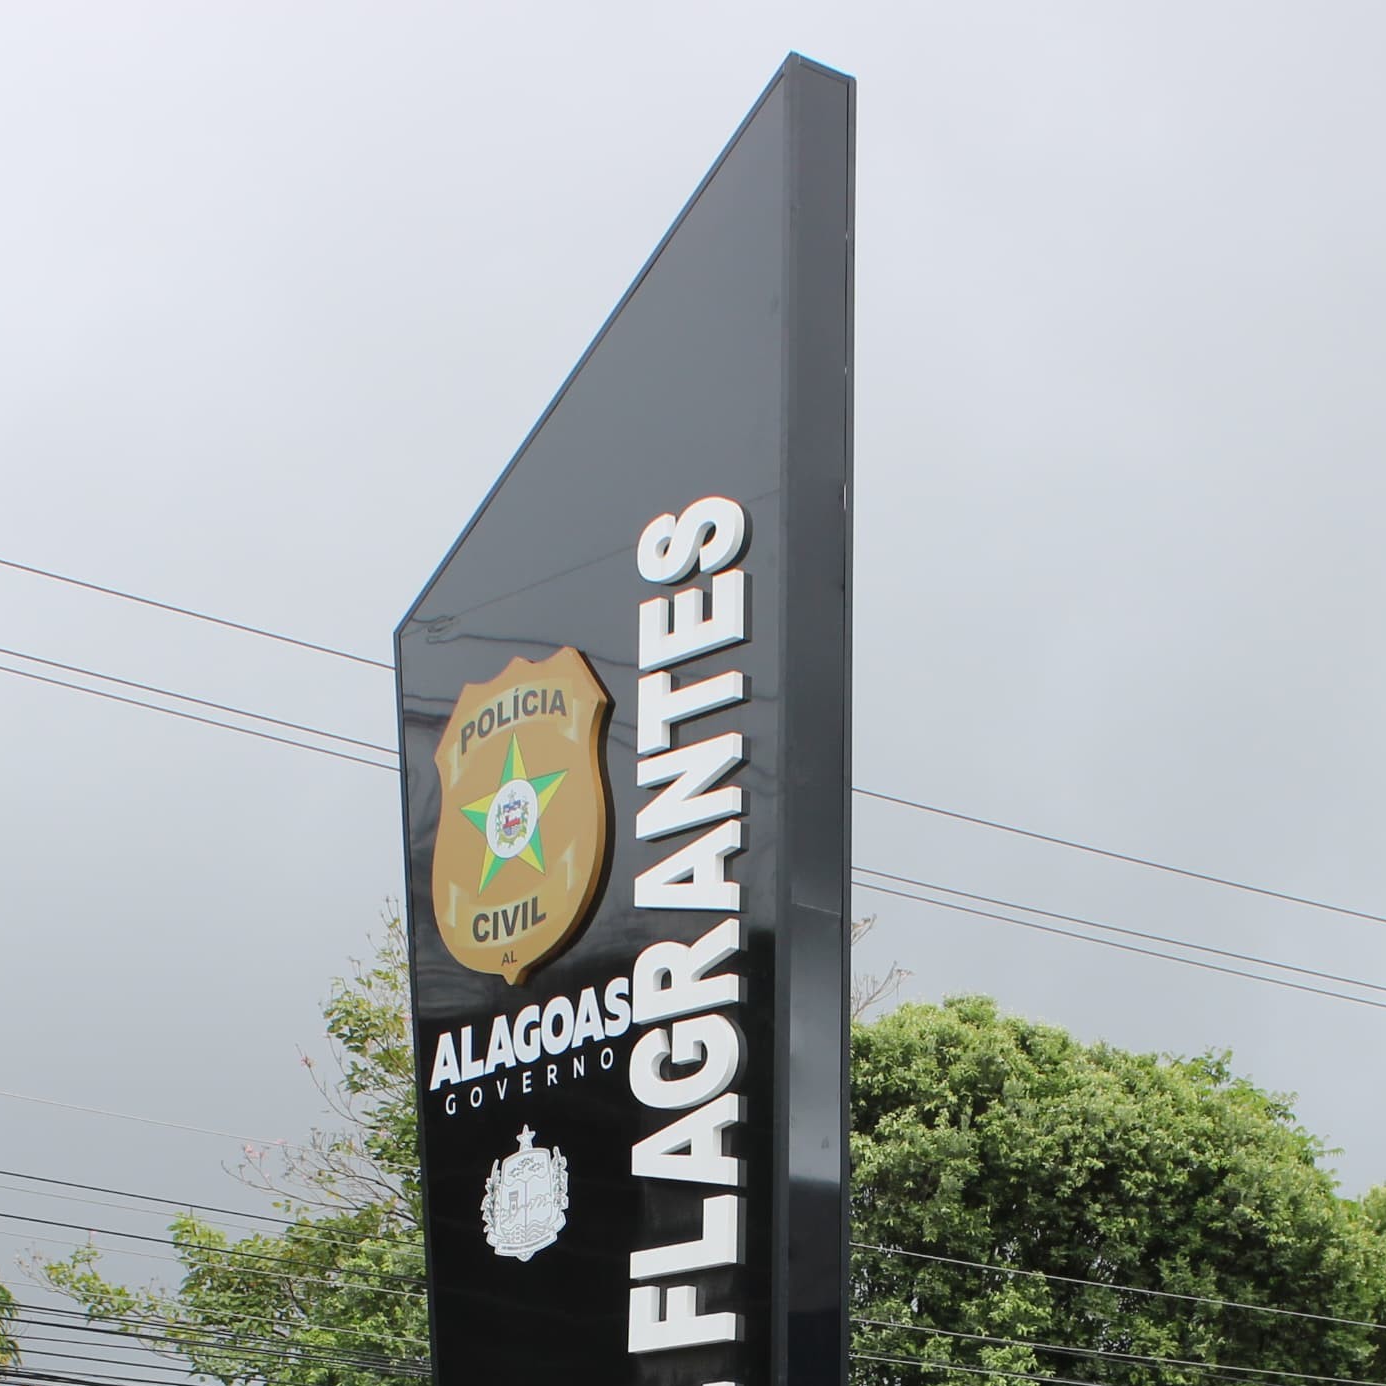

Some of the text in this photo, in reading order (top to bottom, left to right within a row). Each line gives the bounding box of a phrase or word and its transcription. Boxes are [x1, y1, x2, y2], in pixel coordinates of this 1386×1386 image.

[461, 688, 567, 756] POLÍCIA
[473, 896, 547, 943] CIVIL
[629, 496, 751, 1355] FLAGRANTES
[501, 950, 517, 966] AL
[429, 977, 631, 1091] ALAGOAS
[445, 1047, 614, 1115] GOVERNO
